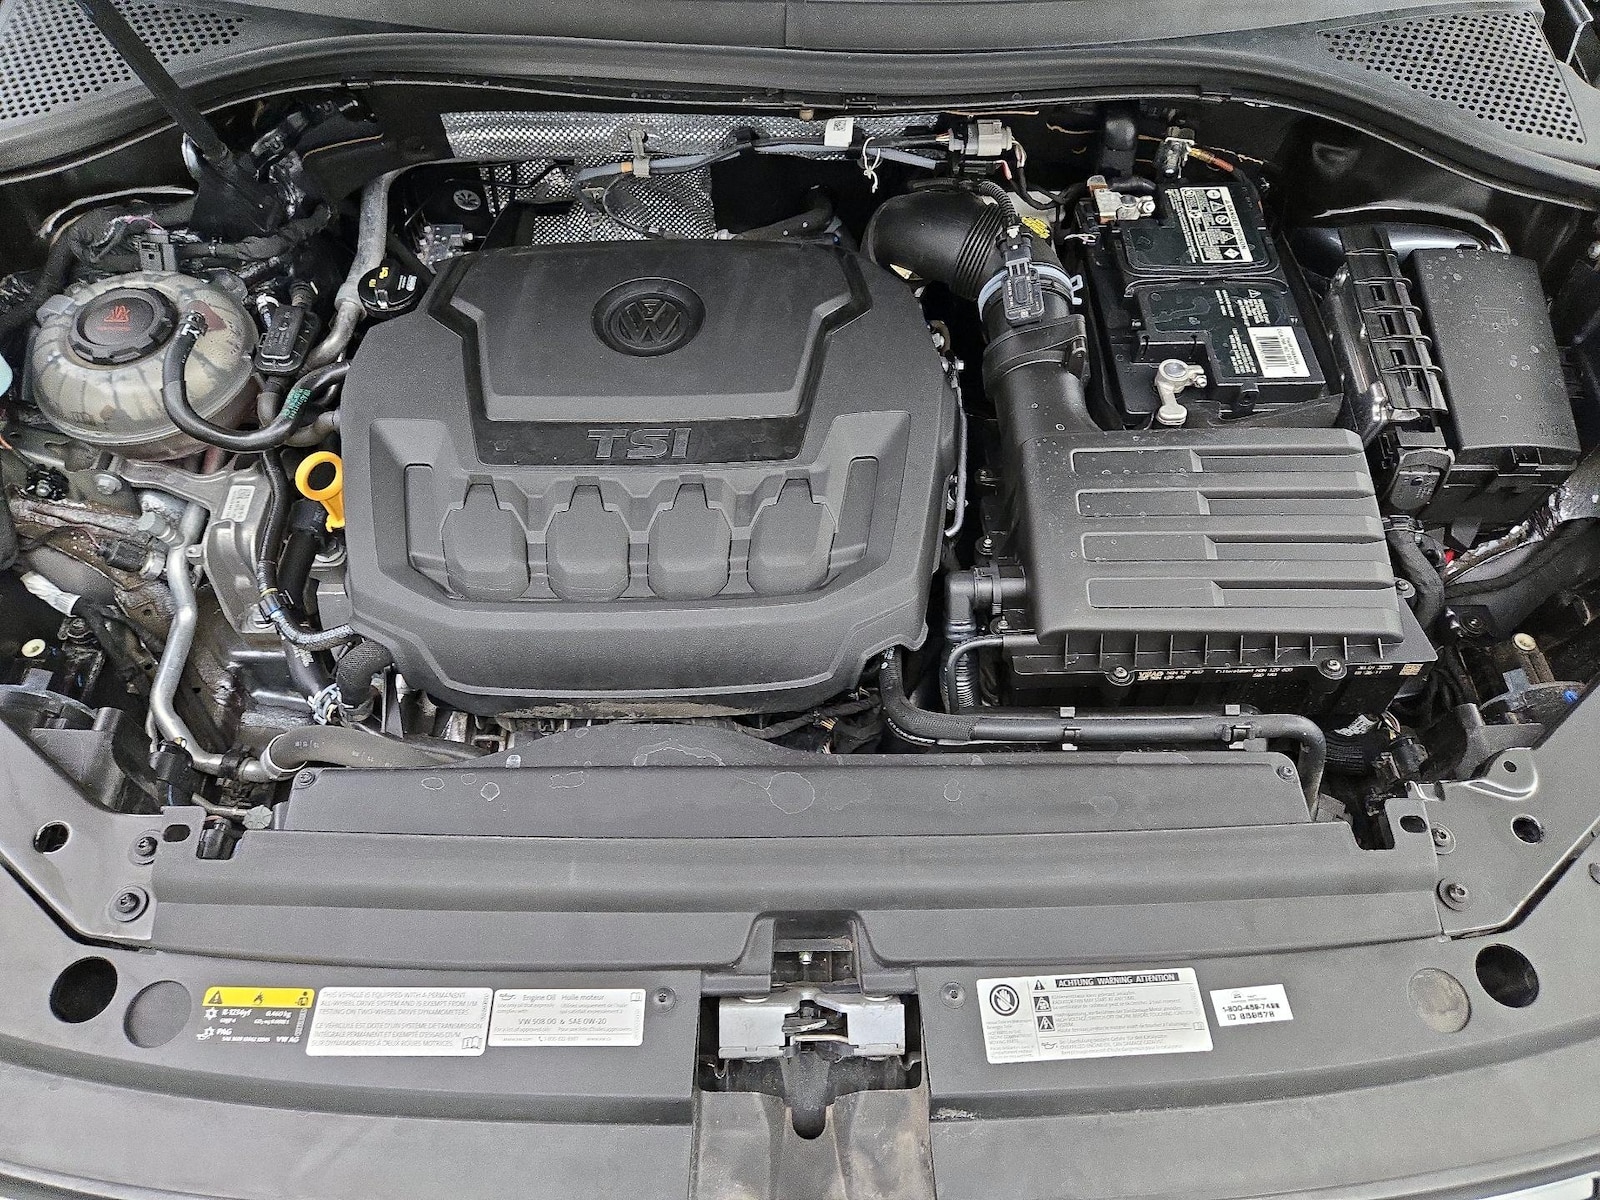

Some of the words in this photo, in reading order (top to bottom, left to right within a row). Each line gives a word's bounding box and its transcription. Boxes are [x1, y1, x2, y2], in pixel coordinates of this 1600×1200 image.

[587, 427, 692, 460] TSI
[1058, 978, 1094, 987] ACHTUNG
[1096, 976, 1133, 985] WARNING
[1135, 974, 1176, 982] ATTENTION
